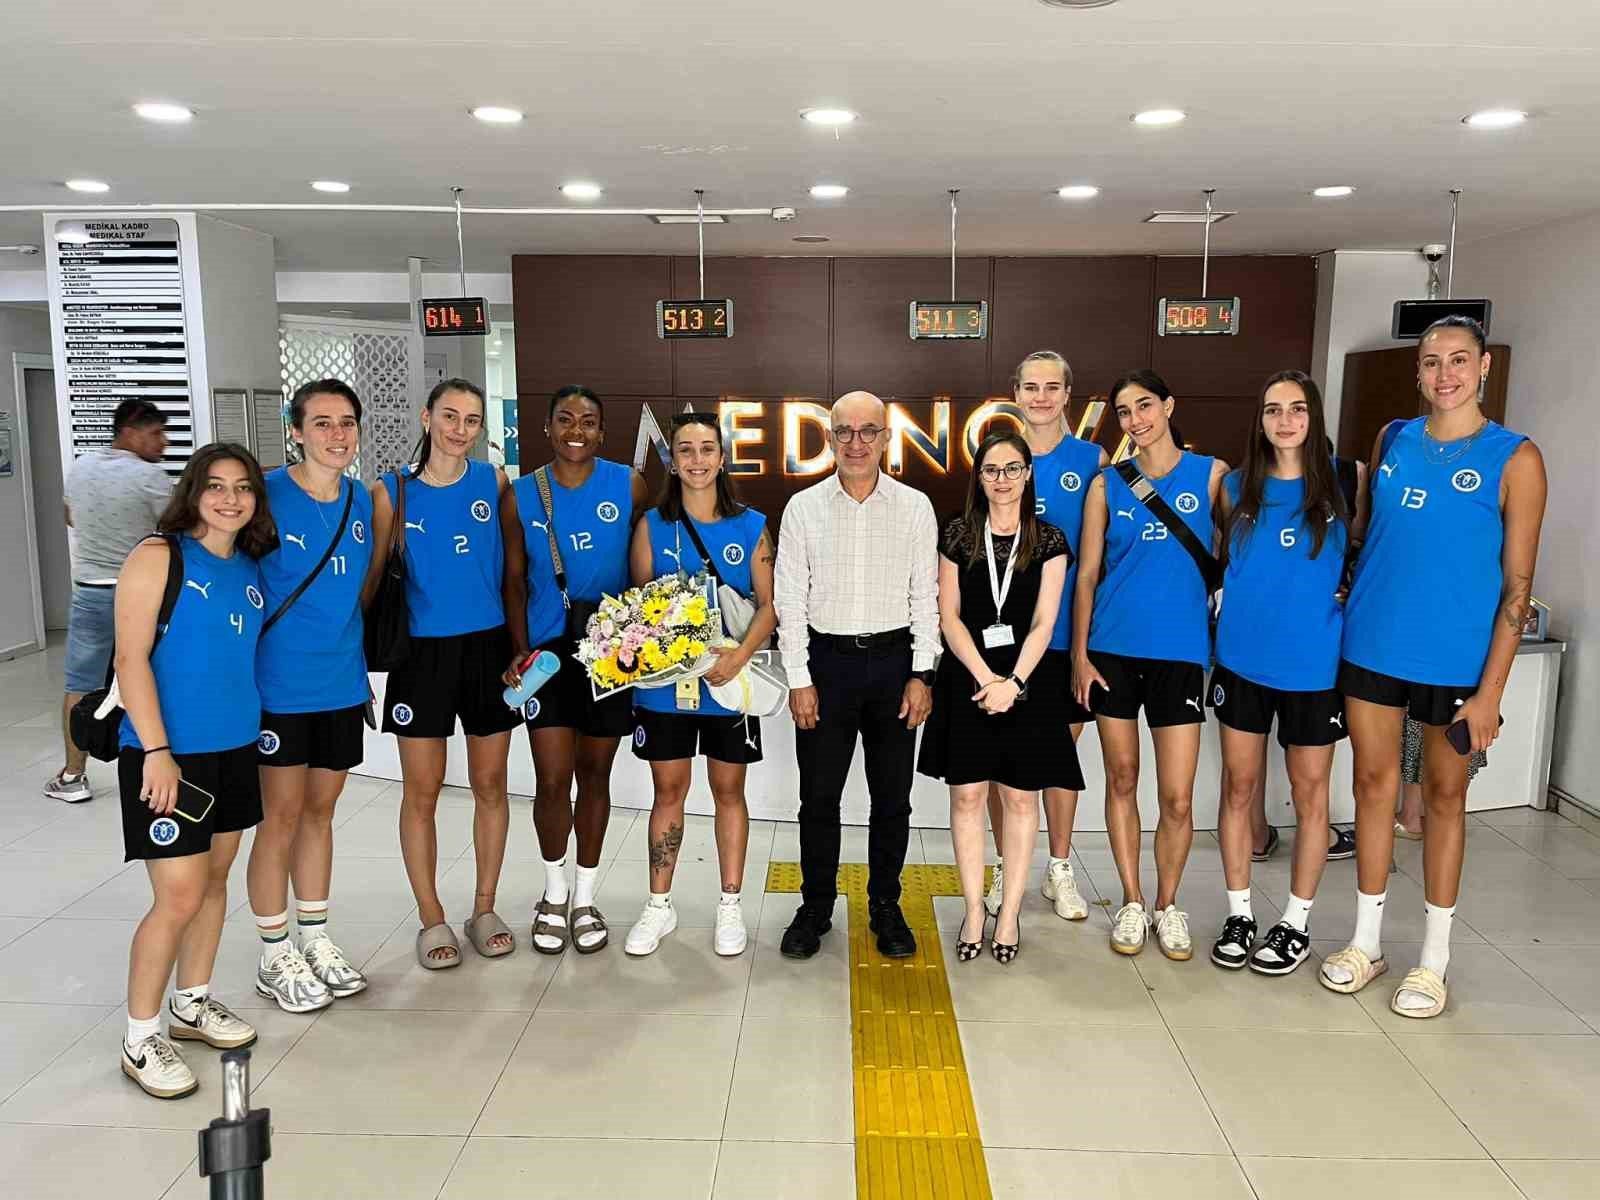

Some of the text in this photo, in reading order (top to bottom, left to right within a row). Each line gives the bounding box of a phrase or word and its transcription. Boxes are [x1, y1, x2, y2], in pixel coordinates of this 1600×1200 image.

[425, 307, 484, 329] 614 1
[664, 309, 725, 330] 513 2
[918, 310, 979, 331] 511 3
[1219, 306, 1231, 324] 4
[1401, 487, 1427, 509] 13
[569, 532, 594, 551] 12
[1142, 521, 1168, 541] 23
[1280, 528, 1296, 548] 6
[453, 535, 470, 554] 2
[330, 555, 346, 576] 11
[230, 613, 243, 635] 4
